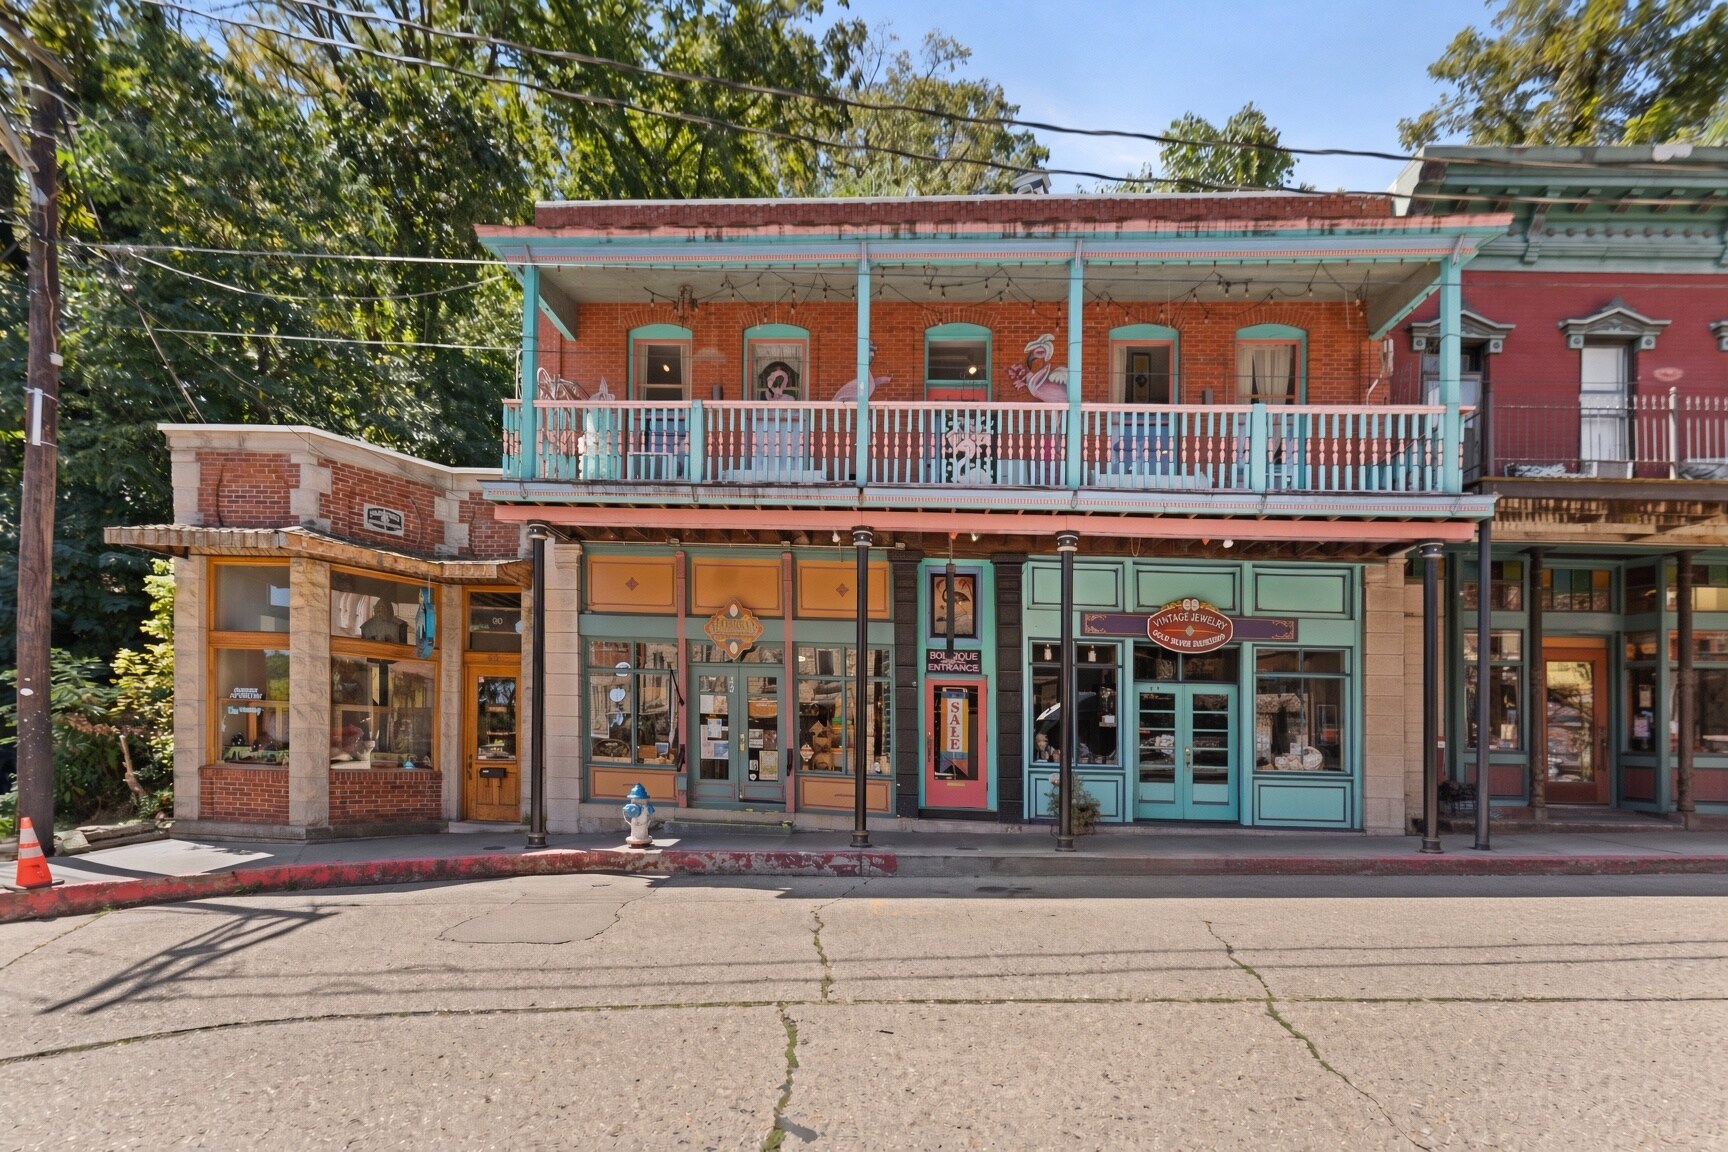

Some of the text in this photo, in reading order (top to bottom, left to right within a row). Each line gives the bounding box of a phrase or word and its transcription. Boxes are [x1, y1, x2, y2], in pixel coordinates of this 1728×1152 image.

[1153, 612, 1227, 630] VINTAGE JEWELRY
[1152, 629, 1169, 642] GOLD
[929, 651, 979, 661] BOIQUE
[928, 663, 980, 672] ENTRANCE
[950, 701, 960, 750] SALE
